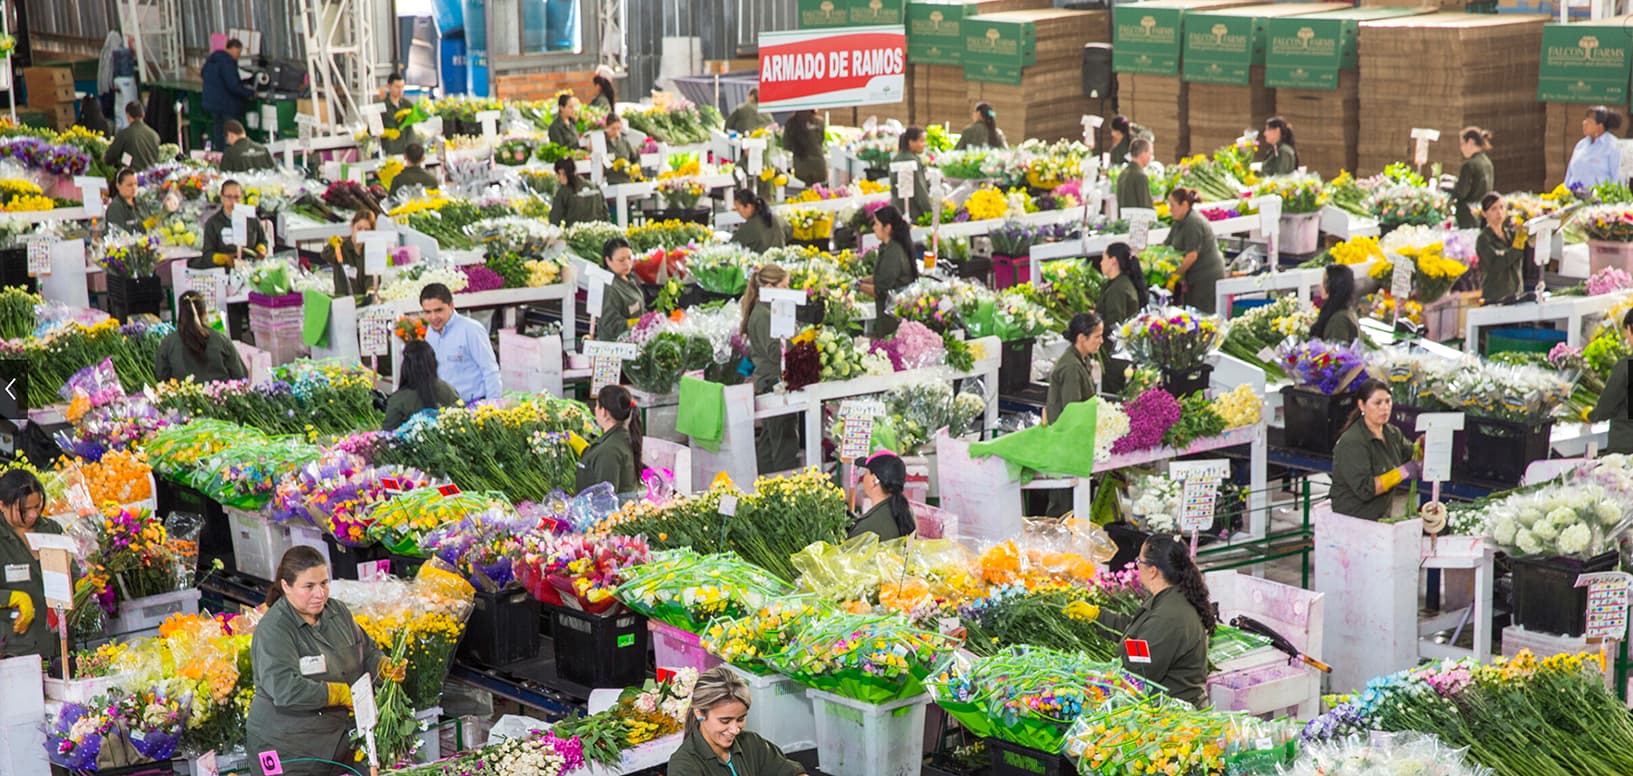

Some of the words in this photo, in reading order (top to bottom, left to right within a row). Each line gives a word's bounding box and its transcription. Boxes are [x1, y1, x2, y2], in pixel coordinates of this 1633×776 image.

[1547, 46, 1585, 57] FALCON
[1594, 48, 1624, 57] FARMS
[761, 53, 826, 82] ARMADO
[829, 51, 849, 78] DE
[852, 48, 903, 76] RAMOS
